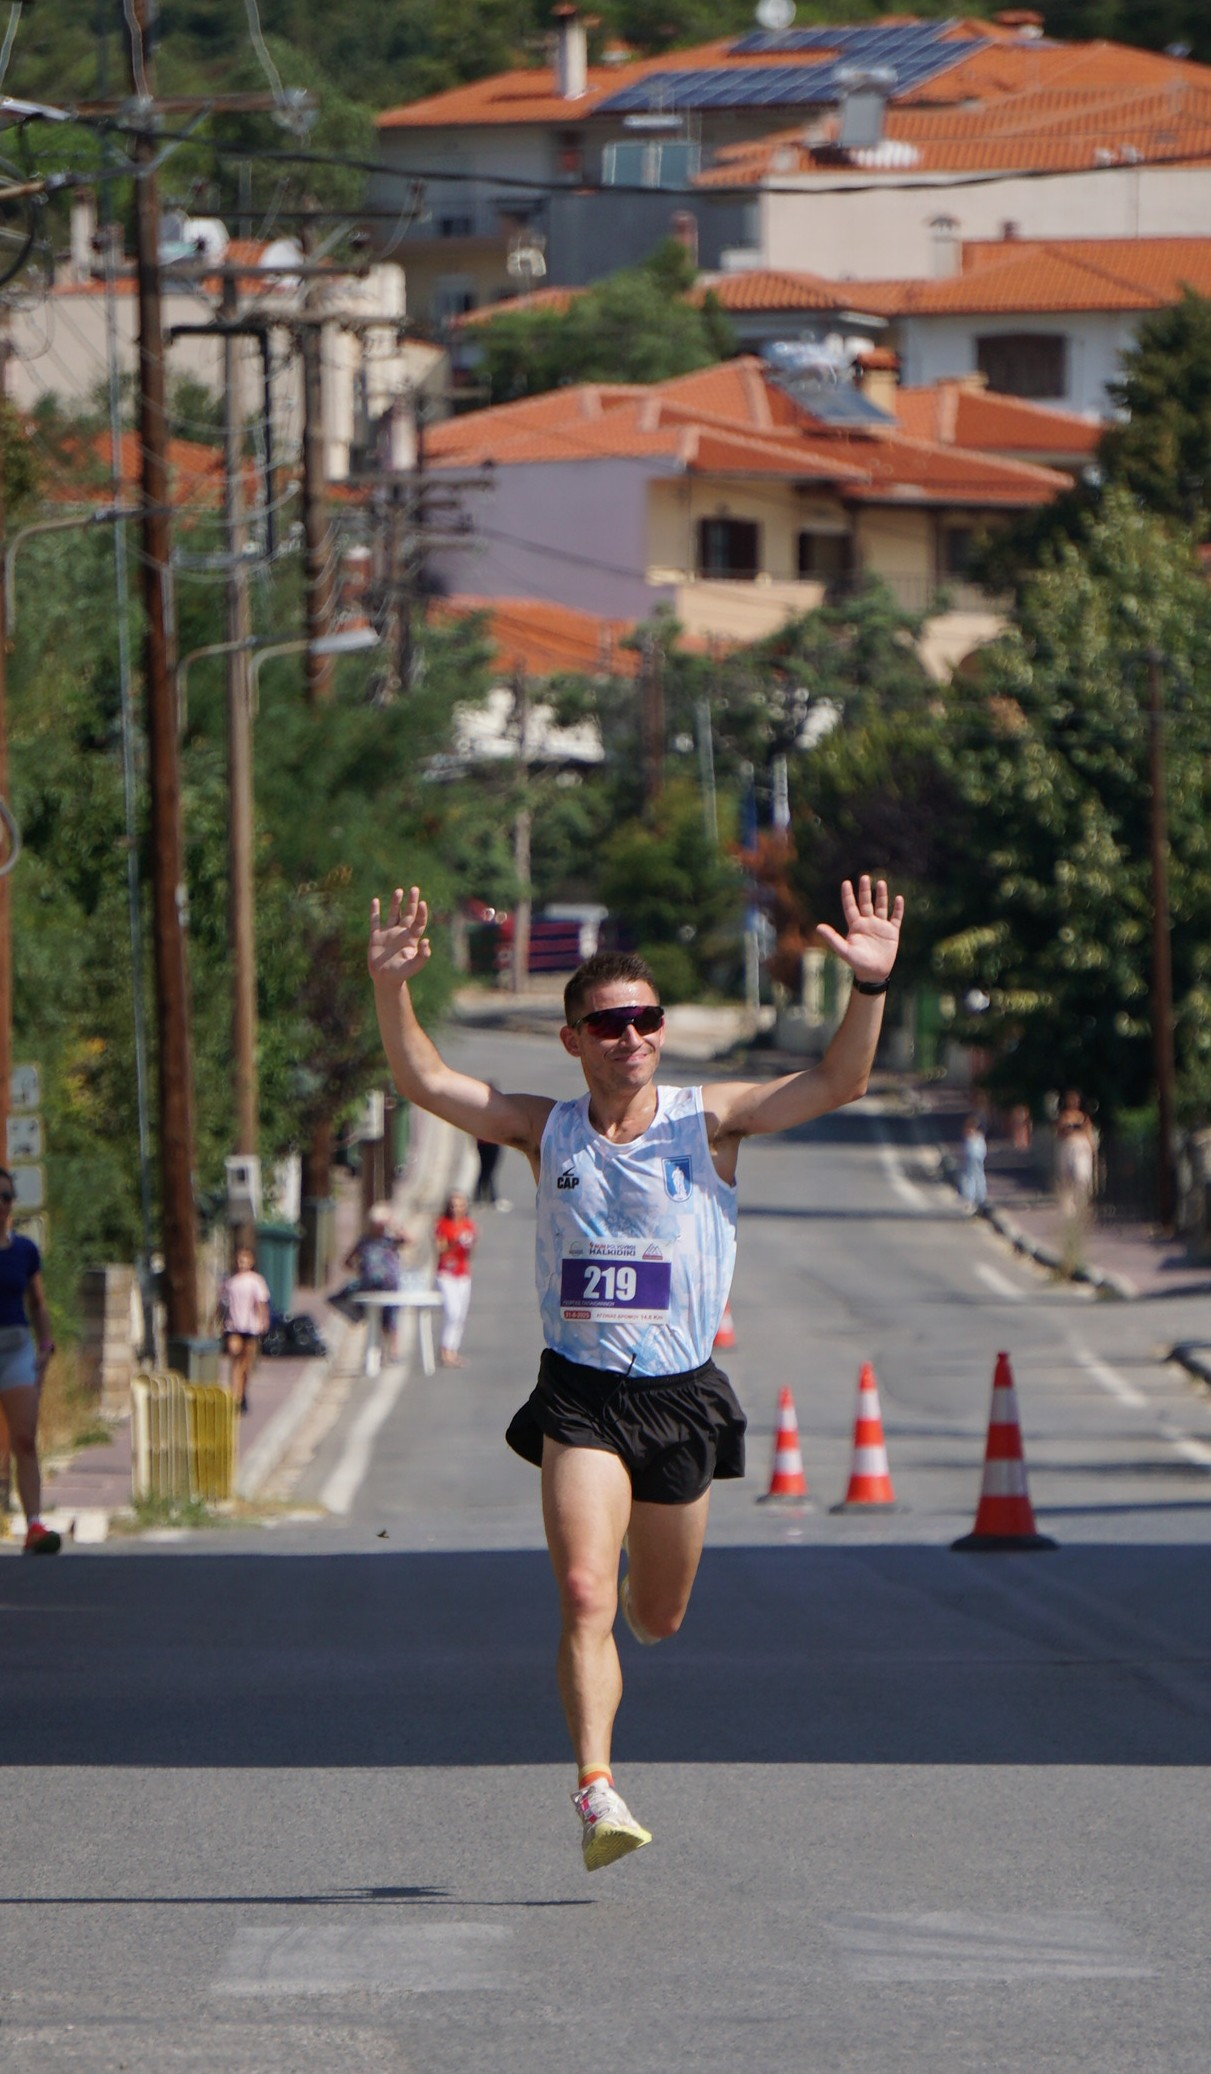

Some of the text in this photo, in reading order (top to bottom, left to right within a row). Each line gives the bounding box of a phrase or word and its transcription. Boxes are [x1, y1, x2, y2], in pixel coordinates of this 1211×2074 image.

[557, 1177, 580, 1189] CAP
[589, 1249, 637, 1257] HALKIDIKI
[583, 1265, 637, 1301] 219
